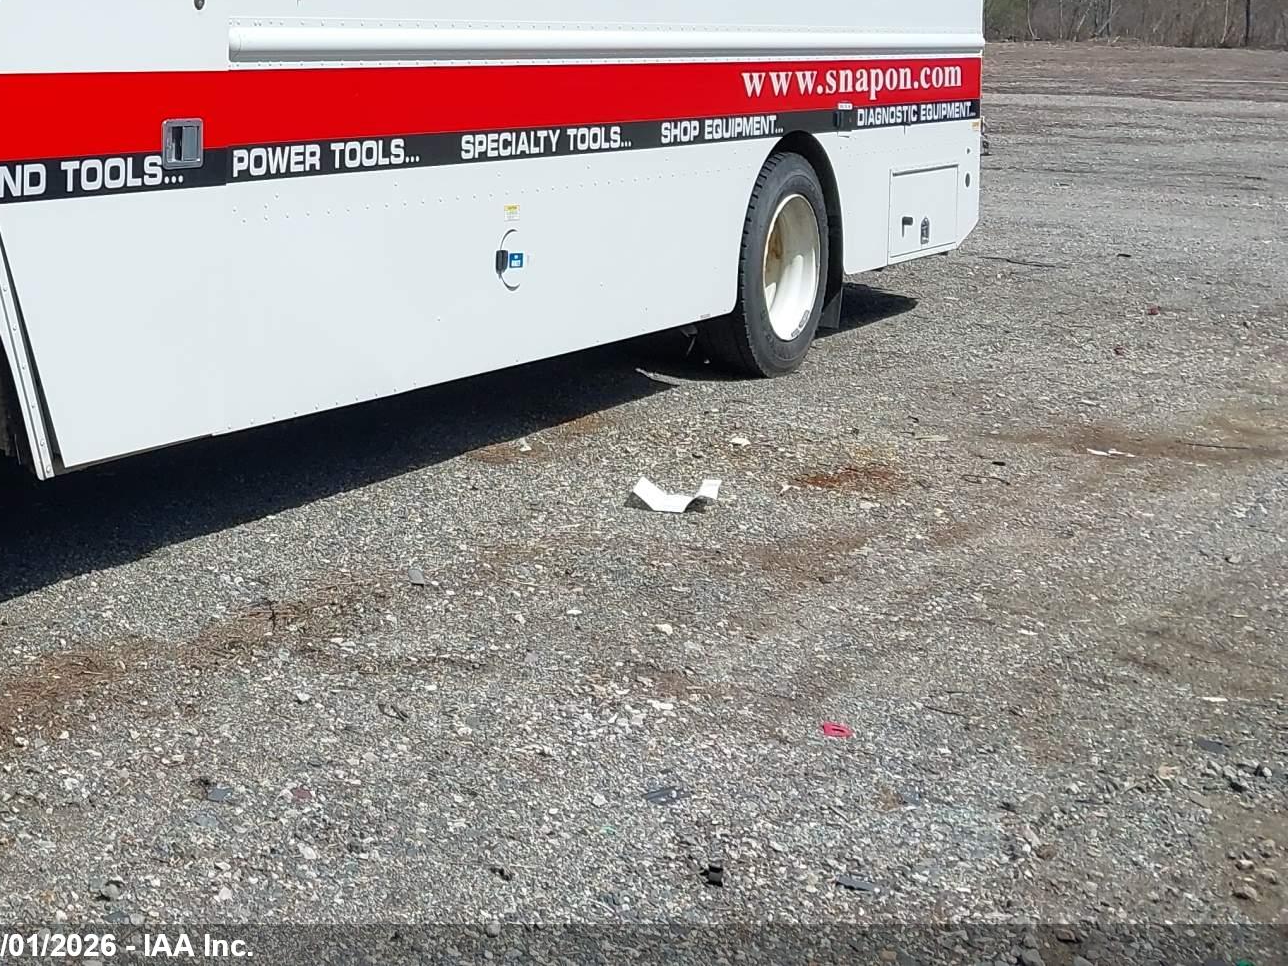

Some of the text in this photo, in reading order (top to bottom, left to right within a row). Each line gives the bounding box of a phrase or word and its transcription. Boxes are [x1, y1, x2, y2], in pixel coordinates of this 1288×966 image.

[741, 65, 963, 100] www.snapon.com
[660, 114, 784, 144] SHOP EQUIPMENT...
[856, 103, 918, 127] DIAGNOSTIC
[232, 138, 420, 178] POWER TOOLS...
[460, 125, 632, 160] SPECIALTY TOOLS...
[61, 155, 184, 193] TOOLS...
